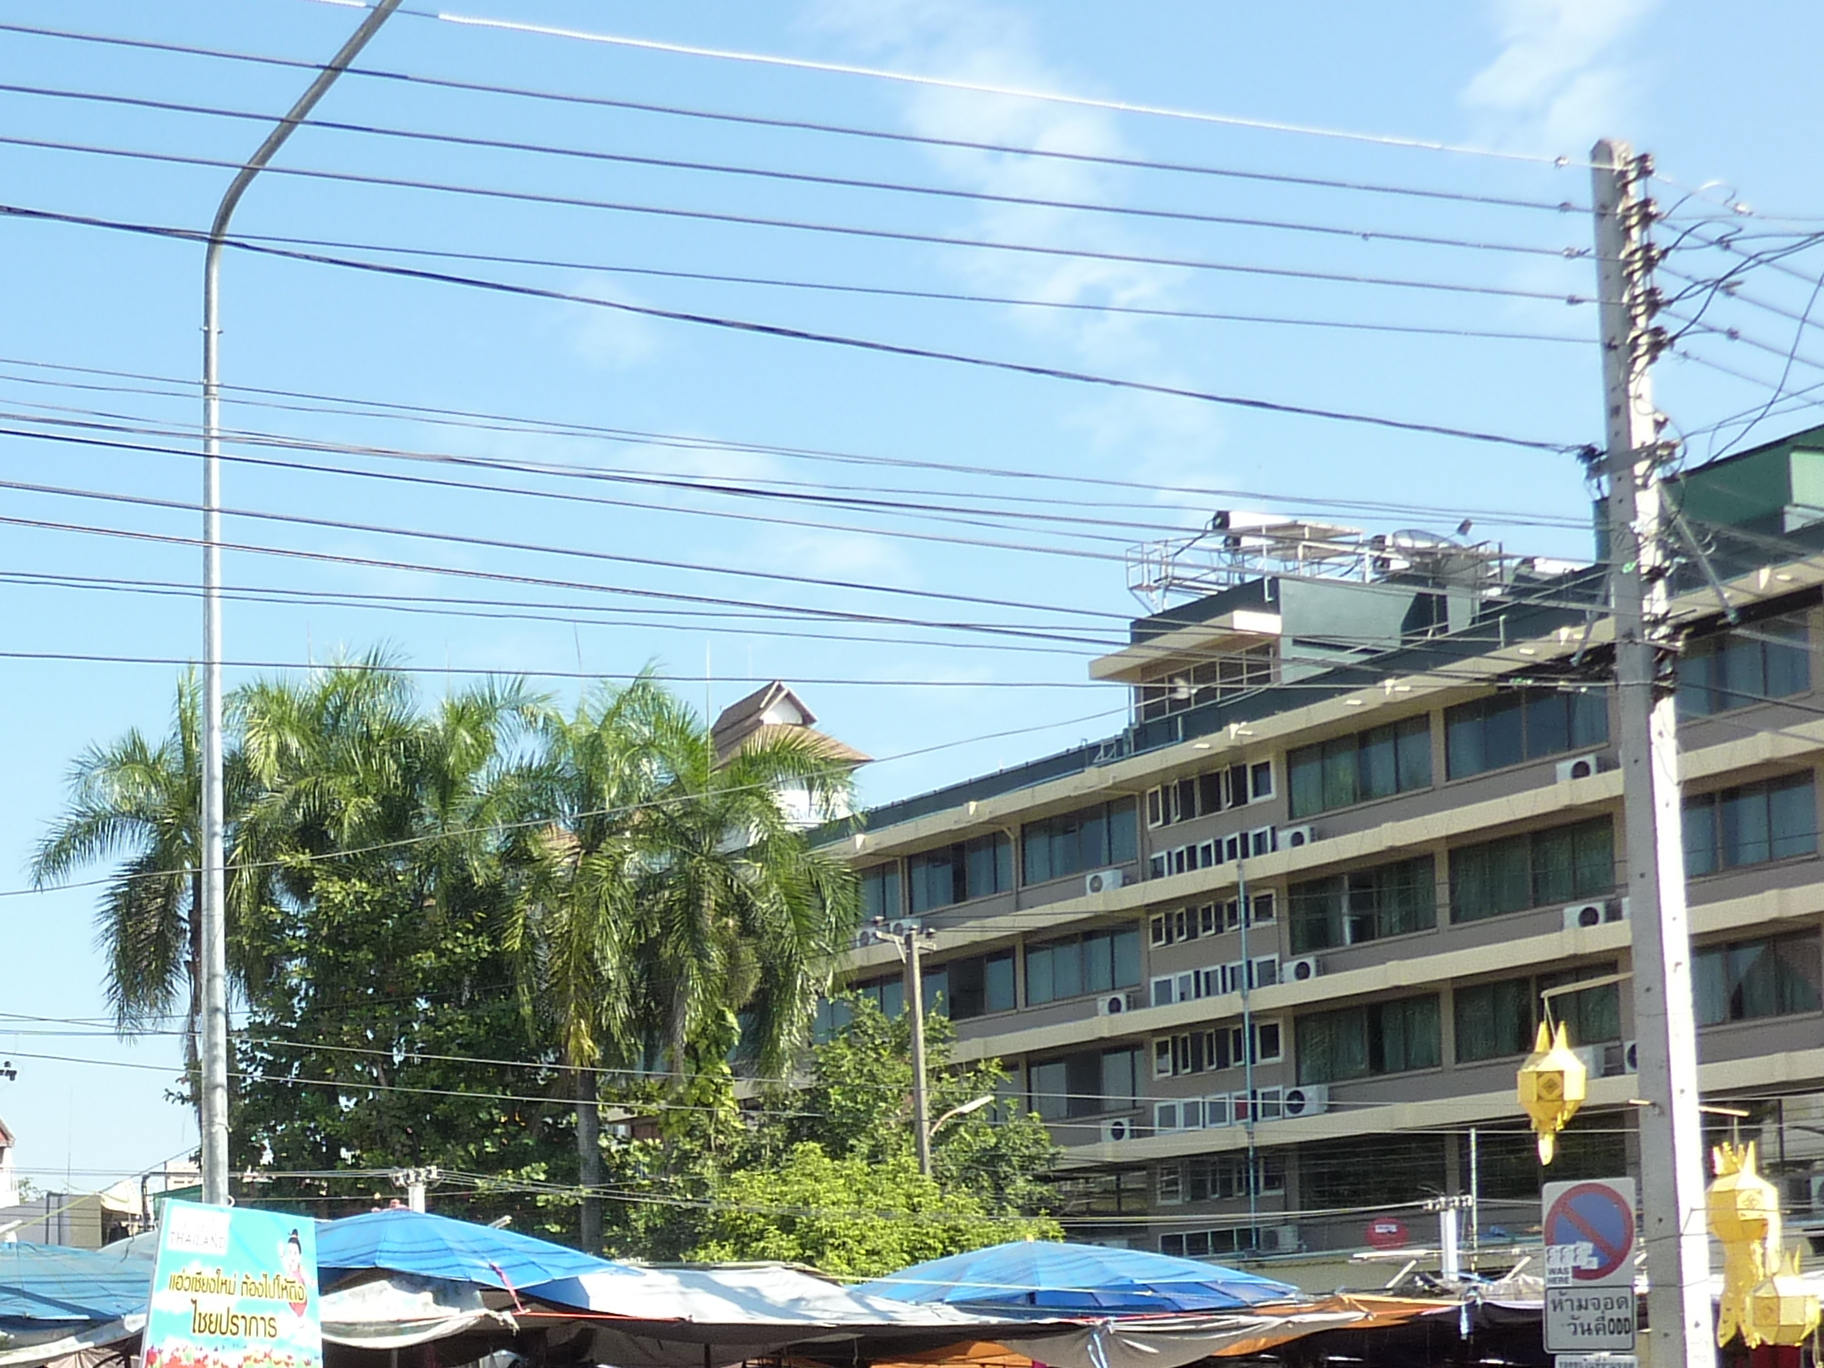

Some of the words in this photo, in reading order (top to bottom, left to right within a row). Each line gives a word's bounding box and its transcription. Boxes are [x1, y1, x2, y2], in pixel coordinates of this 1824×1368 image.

[1551, 1290, 1630, 1312] ห้ามจอด
[190, 1297, 278, 1338] ไชยปราการ
